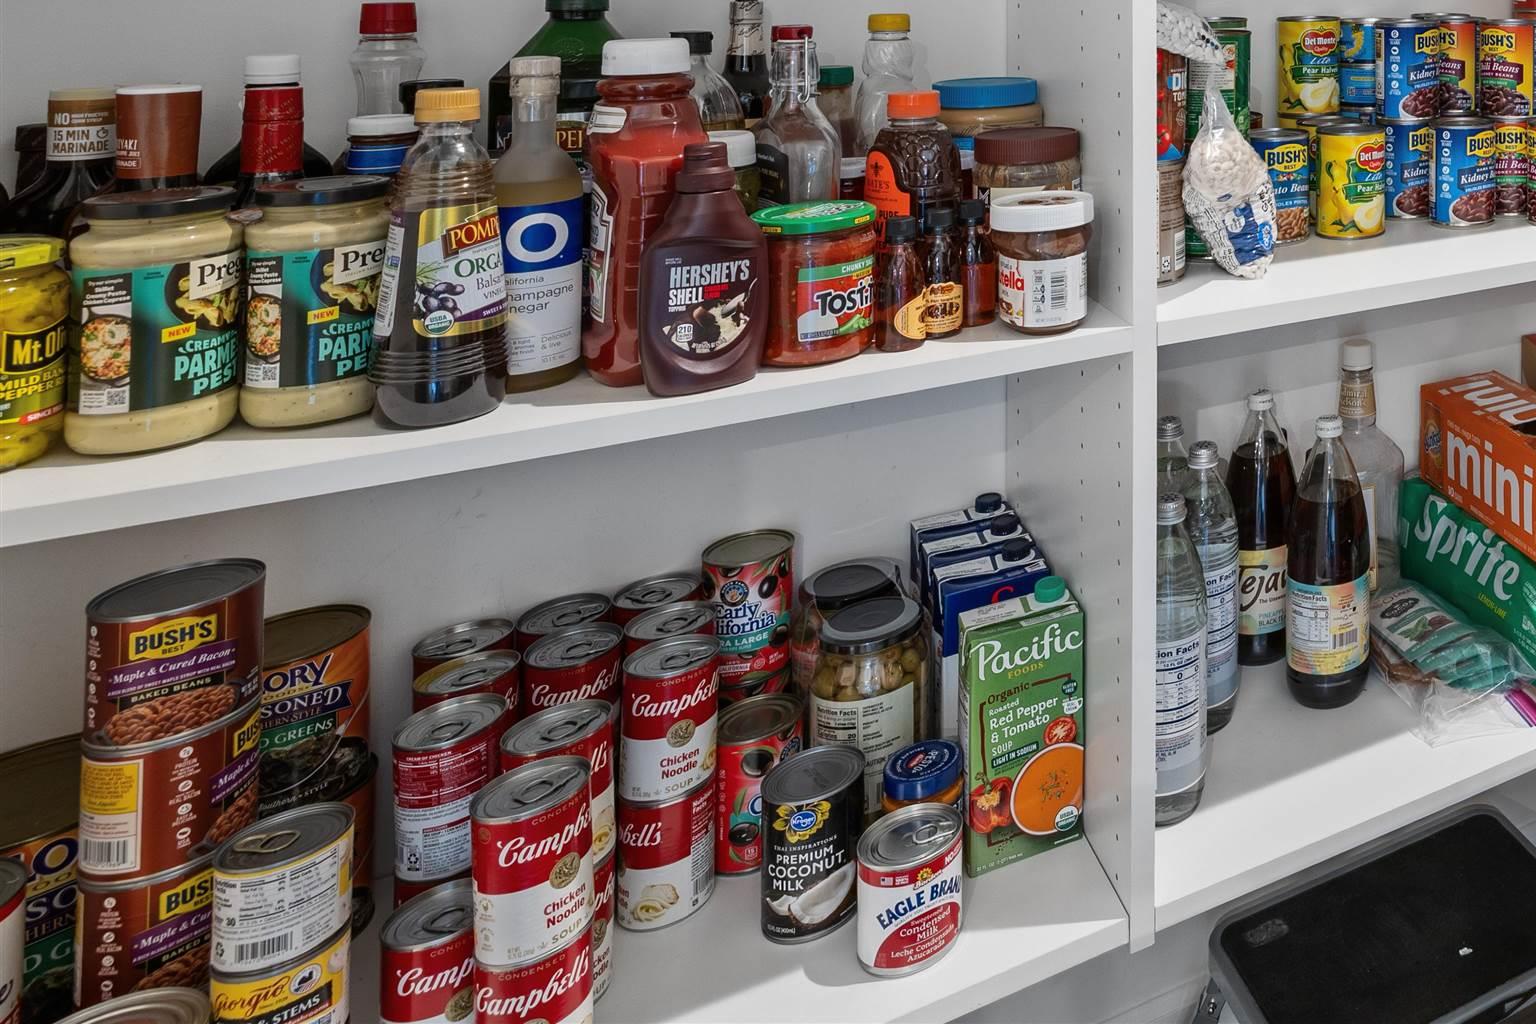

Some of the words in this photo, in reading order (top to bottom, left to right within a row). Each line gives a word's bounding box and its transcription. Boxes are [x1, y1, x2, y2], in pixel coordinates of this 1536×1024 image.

[1302, 67, 1319, 75] Pear
[1409, 67, 1435, 82] Kidney
[1492, 61, 1520, 74] Beans
[54, 112, 70, 125] NO
[53, 129, 64, 141] 15
[65, 129, 90, 141] MIN
[52, 140, 109, 154] MARINADE
[1267, 146, 1308, 168] BUSH'S
[1283, 163, 1297, 171] BEST
[1461, 171, 1489, 185] Kidney
[1357, 184, 1373, 193] Pear
[505, 212, 569, 263] O
[670, 259, 750, 289] HERSHEY'S
[842, 261, 865, 274] CHUNKY
[668, 286, 704, 306] SHELL
[313, 310, 335, 320] NEW
[430, 315, 447, 323] USDA
[168, 326, 192, 338] NEW
[678, 325, 692, 334] 210
[13, 339, 43, 365] Mt.
[1447, 431, 1534, 535] mini
[1415, 495, 1520, 600] Sprite
[1258, 617, 1276, 626] BLACK
[135, 619, 213, 654] BUSH'S
[735, 632, 769, 647] LARGE
[161, 644, 184, 656] BEST
[970, 623, 1084, 681] Pacific
[1176, 641, 1199, 657] Facts
[113, 669, 145, 685] Maple
[159, 658, 194, 674] Cured
[199, 650, 231, 664] Bacon
[1007, 662, 1044, 679] FOODS
[131, 687, 169, 703] BAKED
[174, 676, 212, 691] BEANS
[988, 683, 1029, 704] Organic
[989, 699, 1020, 716] Roasted
[990, 713, 1013, 729] Red
[1016, 696, 1059, 724] Pepper
[275, 718, 333, 744] GREENS
[990, 733, 998, 743] &
[1001, 715, 1050, 738] Tomato
[660, 746, 700, 769] Chicken
[992, 741, 1013, 756] SOUP
[992, 756, 1008, 767] LIGHT
[1016, 744, 1038, 759] SODIUM
[218, 769, 243, 788] Maple
[661, 760, 698, 780] Noodle
[665, 778, 694, 793] SOUP
[776, 844, 834, 865] PREMIUM
[768, 851, 844, 880] COCONUT
[773, 879, 804, 892] MILK
[544, 882, 586, 915] Chicken
[876, 887, 925, 930] EAGLE
[546, 897, 585, 928] Noodle
[899, 908, 951, 937] Condensed
[910, 907, 944, 927] Sweetened
[141, 923, 176, 949] Maple
[552, 918, 582, 943] SOUP
[916, 926, 939, 942] Milk
[891, 944, 918, 959] Leche
[907, 939, 945, 962] Azucarada
[476, 947, 590, 1017] Campbell's
